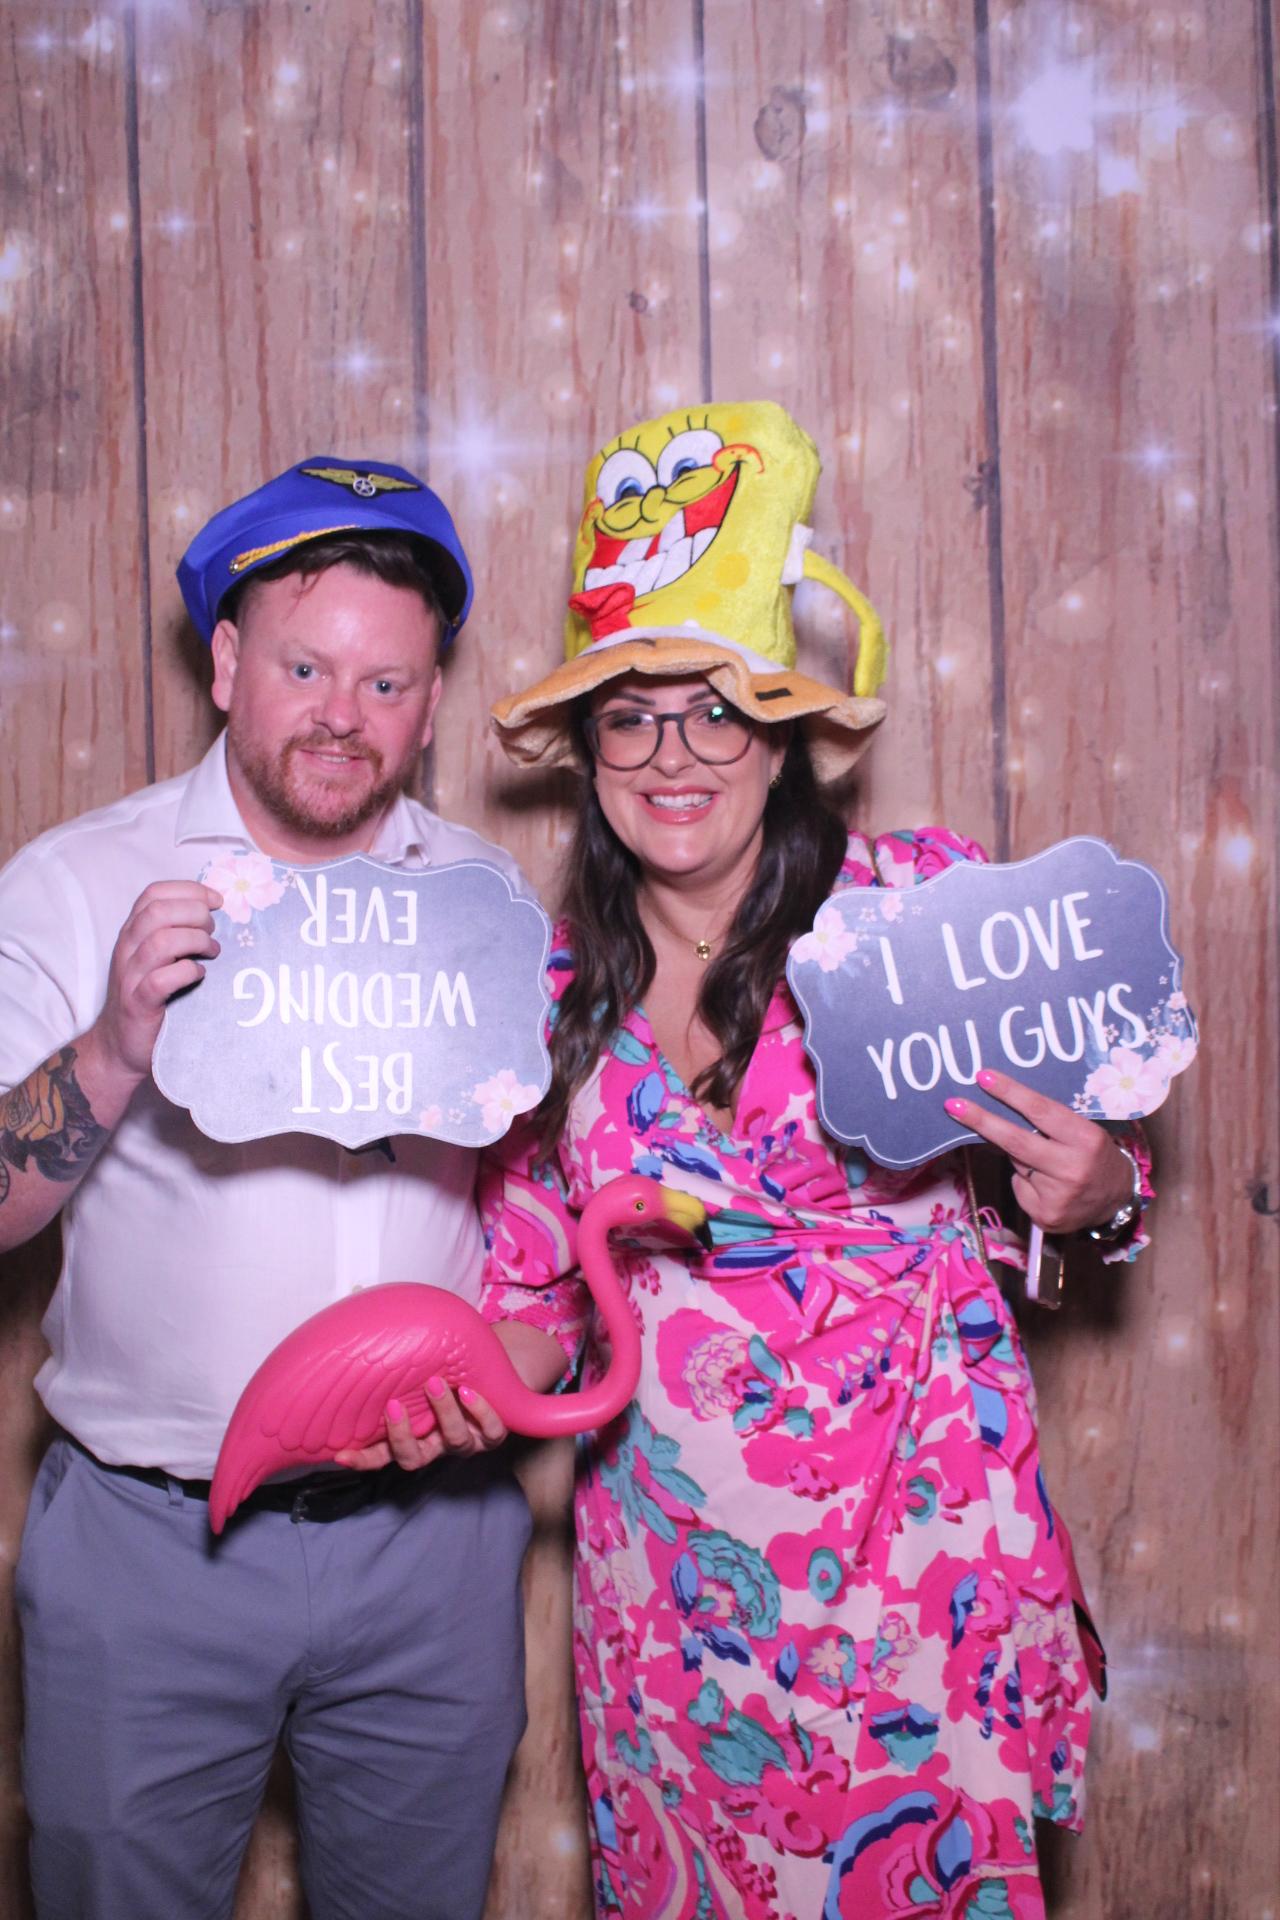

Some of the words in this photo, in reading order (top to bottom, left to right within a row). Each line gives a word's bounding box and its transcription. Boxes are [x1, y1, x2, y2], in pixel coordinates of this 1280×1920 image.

[295, 873, 418, 948] EVER
[879, 935, 904, 1005] I
[941, 891, 1104, 991] LOVE
[232, 963, 477, 1029] WEDDING
[291, 1041, 414, 1115] BEST
[866, 1019, 982, 1100] YOU
[999, 982, 1148, 1069] GUYS
